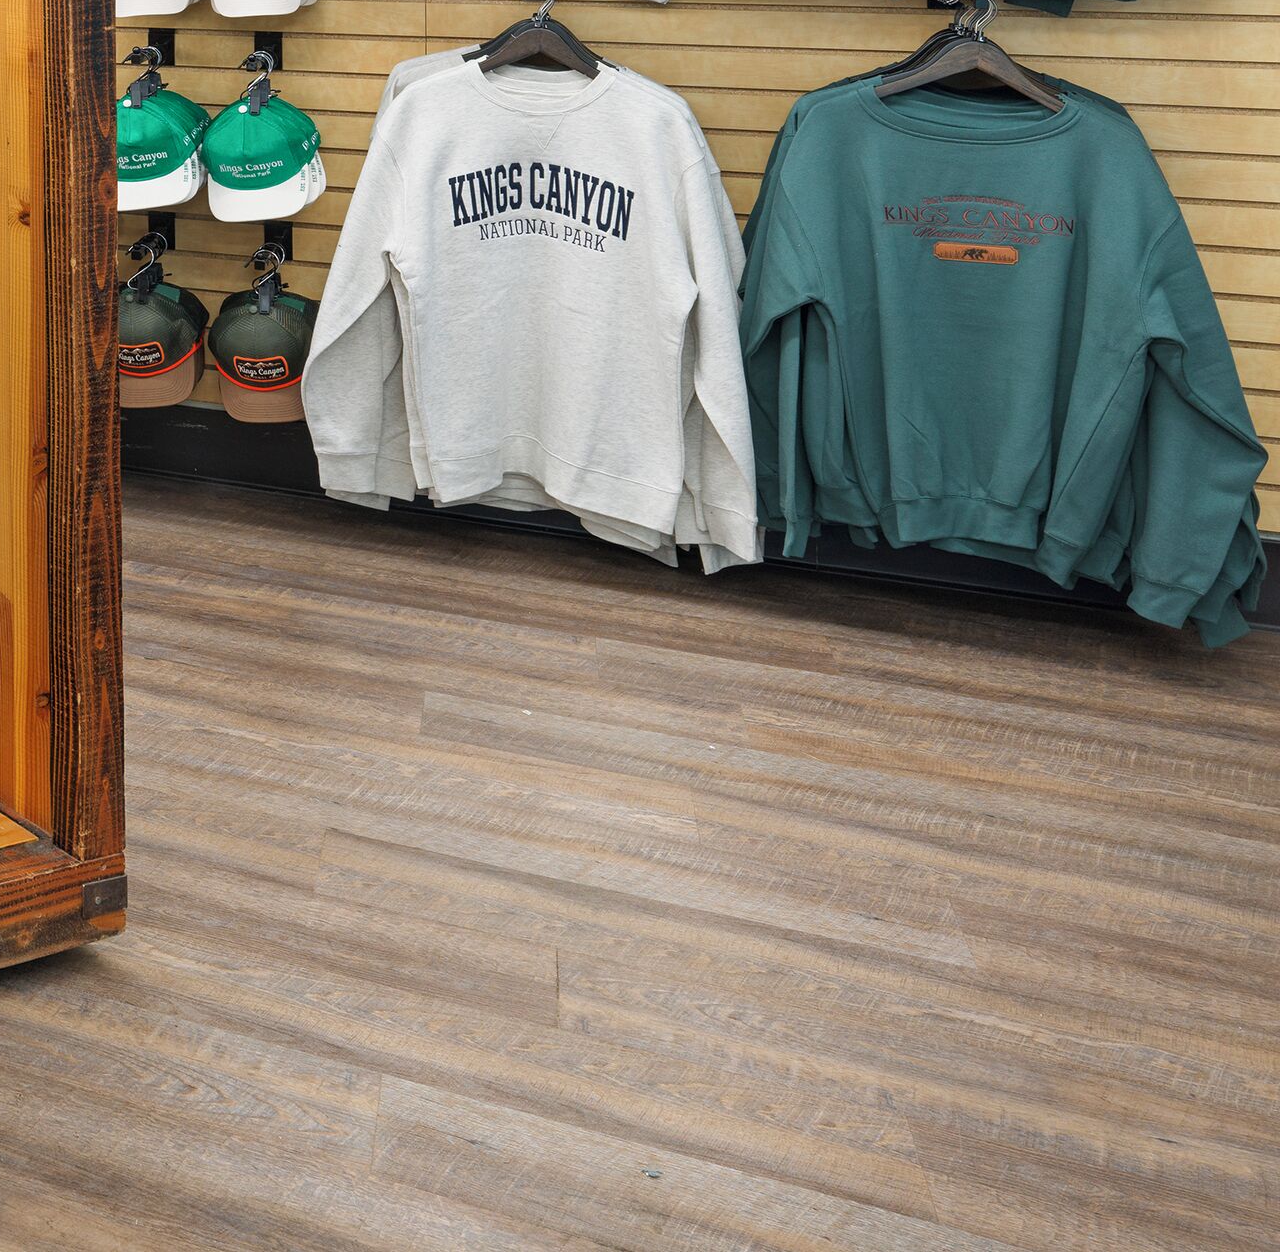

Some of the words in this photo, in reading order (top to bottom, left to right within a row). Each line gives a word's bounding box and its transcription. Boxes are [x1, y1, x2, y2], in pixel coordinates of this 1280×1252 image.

[132, 151, 168, 164] Canyon
[219, 164, 243, 173] Kings
[246, 160, 283, 173] Canyon
[449, 163, 522, 227] KINGS
[530, 162, 634, 241] CANYON
[884, 204, 948, 223] KINGS
[963, 209, 1074, 234] CANYON
[479, 219, 558, 240] NATIONAL
[563, 225, 607, 252] PARK
[136, 353, 160, 363] Canyon
[238, 366, 258, 376] Kings
[258, 366, 285, 377] Canyon
